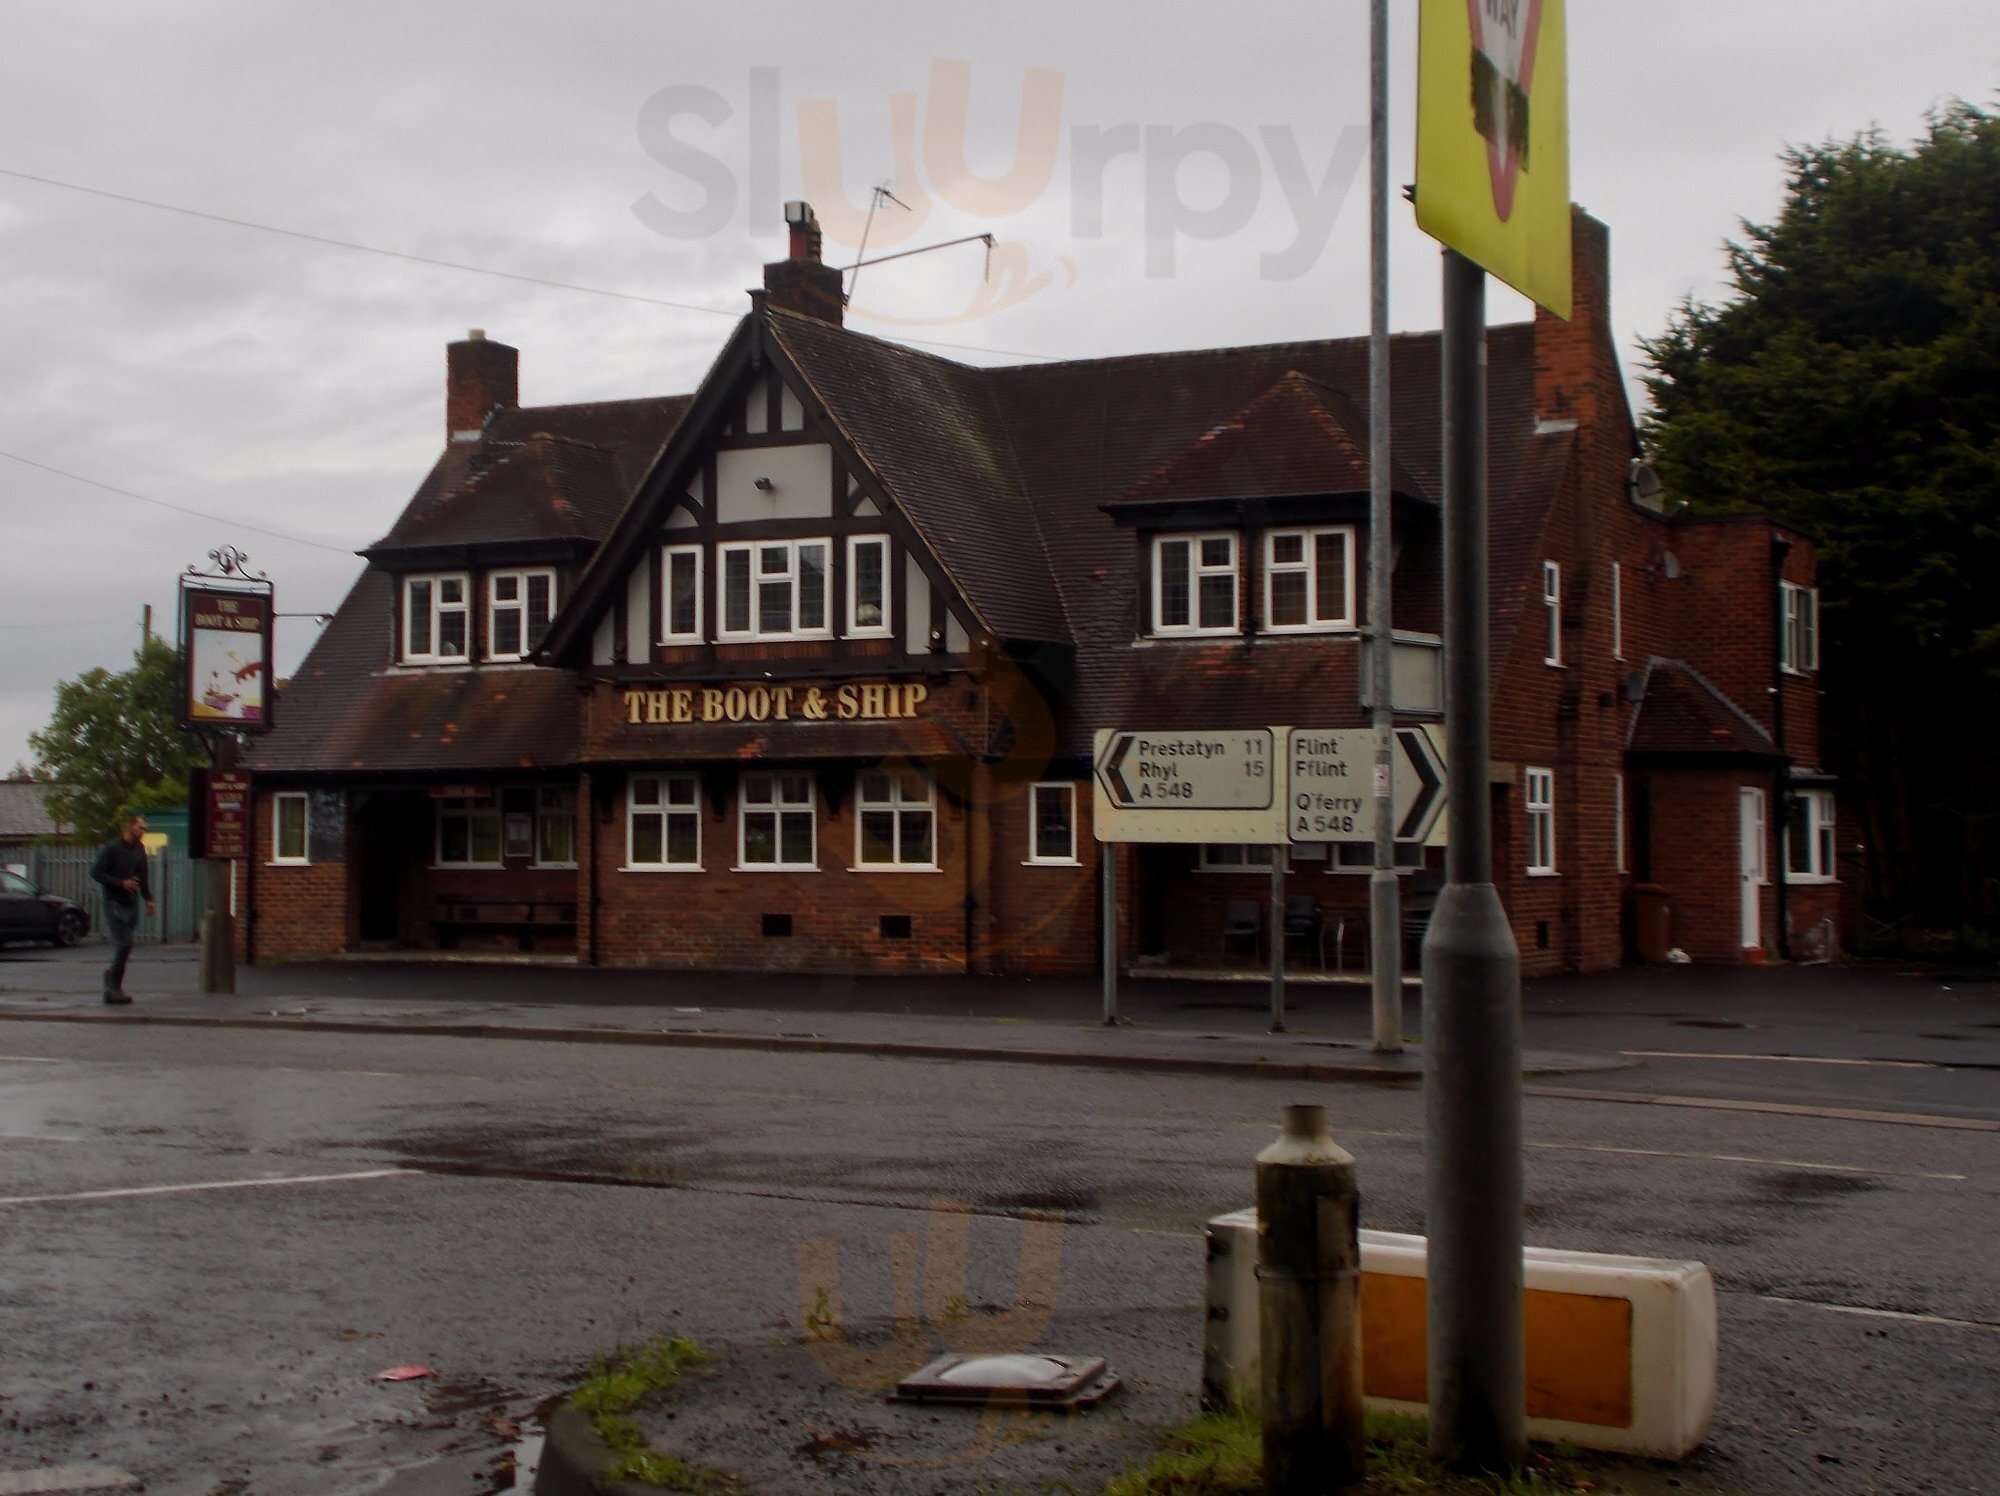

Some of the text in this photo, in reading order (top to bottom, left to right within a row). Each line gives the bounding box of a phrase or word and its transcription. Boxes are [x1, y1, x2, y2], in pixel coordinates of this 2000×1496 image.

[624, 683, 927, 724] THE BOOT & SHIP
[1138, 738, 1262, 759] Prestatyn 11
[1295, 738, 1339, 755] Flint
[1138, 760, 1264, 781] Rhyl 15
[1295, 760, 1348, 777] Fflint
[1139, 781, 1194, 799] A 548
[1296, 792, 1362, 814] Q'ferry
[1297, 815, 1353, 832] A 548
